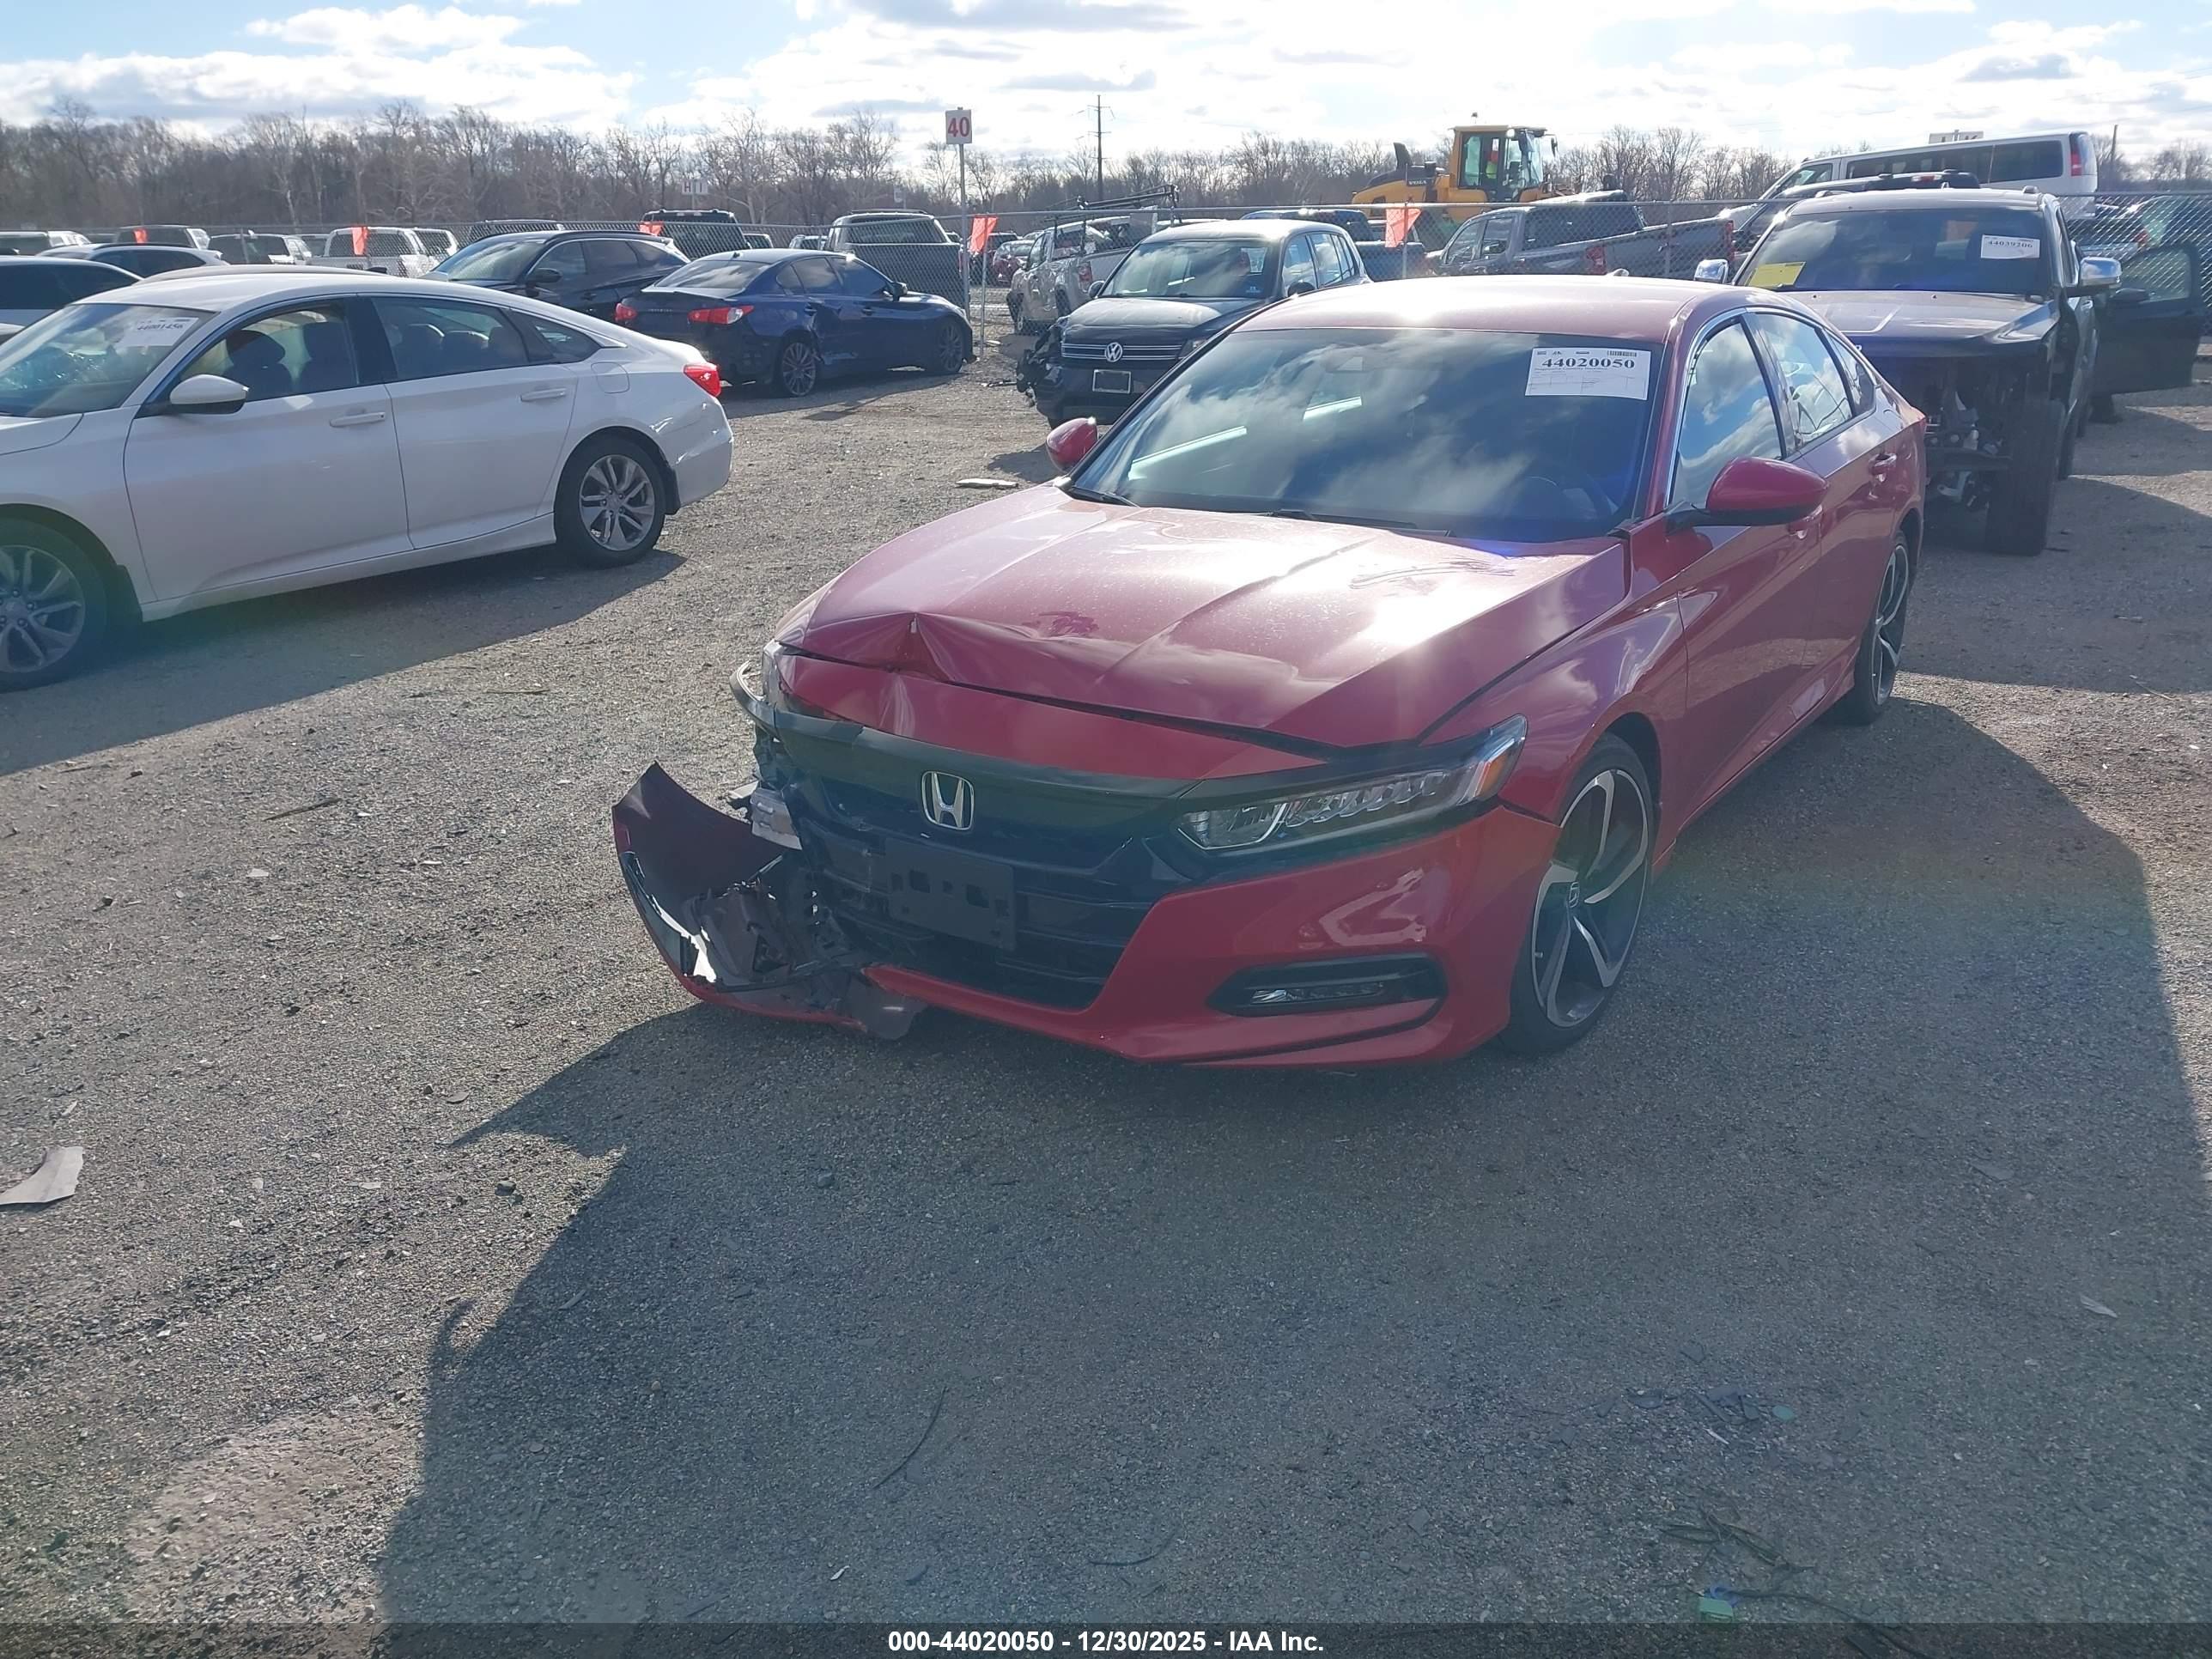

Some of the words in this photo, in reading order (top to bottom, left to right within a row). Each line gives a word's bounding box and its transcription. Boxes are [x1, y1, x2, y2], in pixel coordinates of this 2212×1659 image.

[947, 117, 970, 137] 40
[684, 181, 691, 193] H
[1541, 357, 1635, 369] 44020050
